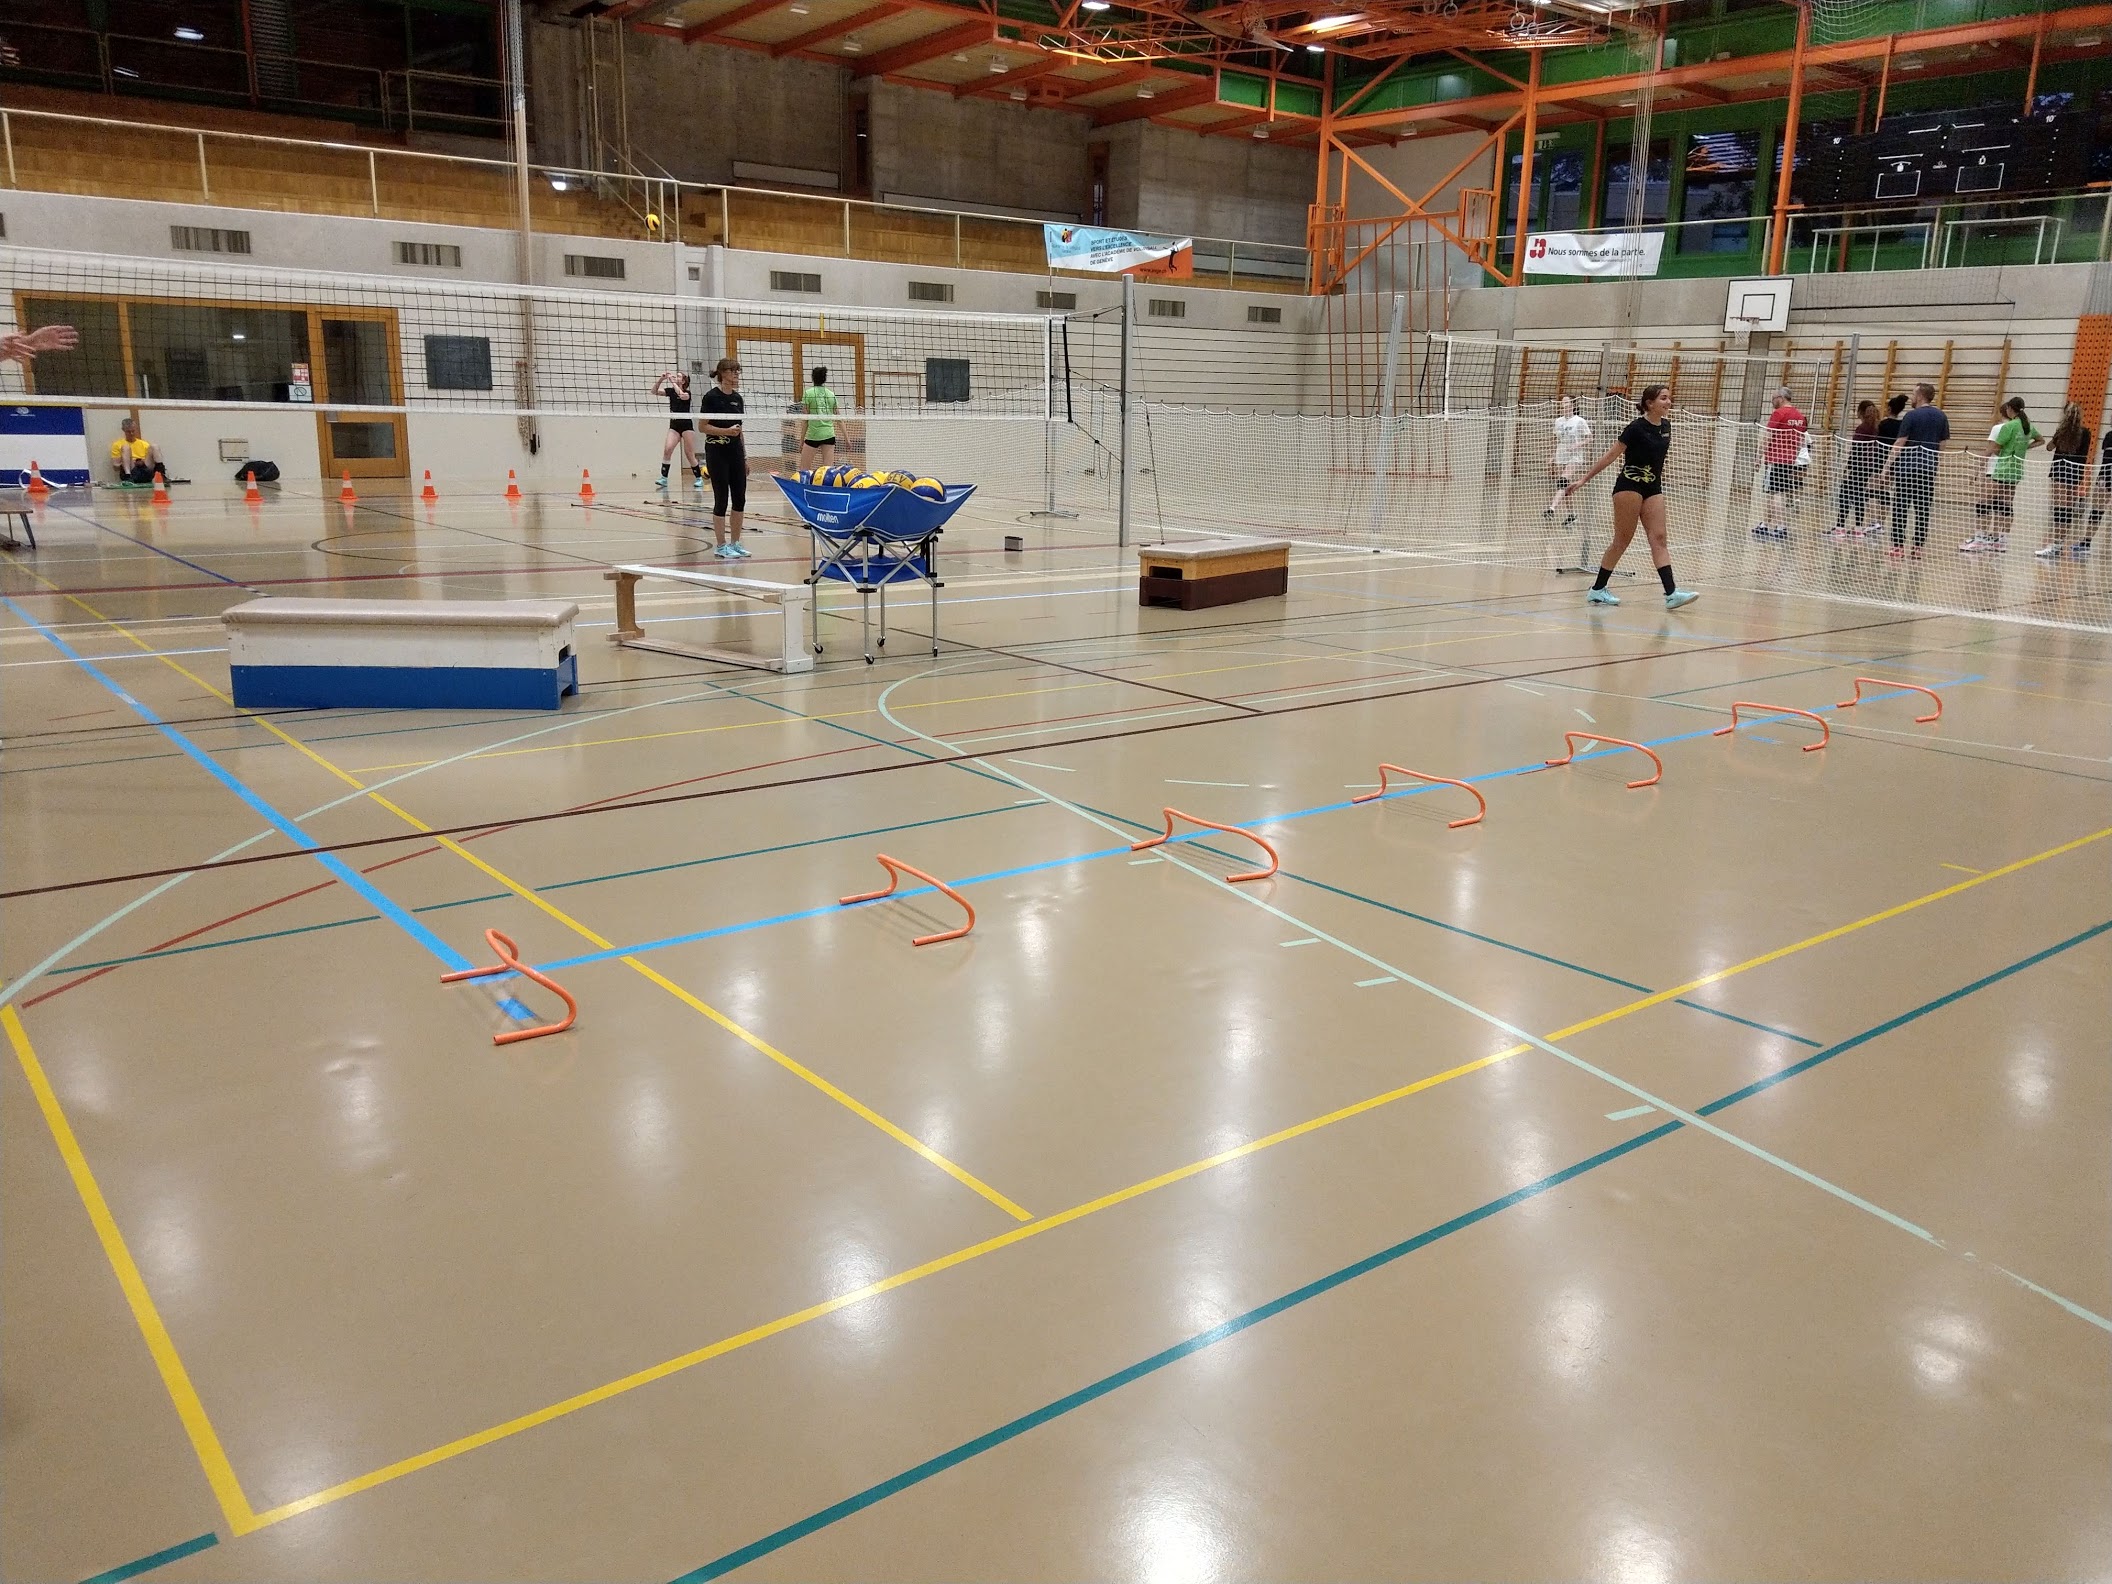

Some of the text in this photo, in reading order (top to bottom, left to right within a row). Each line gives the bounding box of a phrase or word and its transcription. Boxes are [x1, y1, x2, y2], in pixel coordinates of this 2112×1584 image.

[1548, 247, 1566, 256] Nous
[1568, 248, 1597, 257] sommes
[1600, 248, 1610, 257] de
[1612, 247, 1619, 256] la
[816, 512, 839, 524] molten
